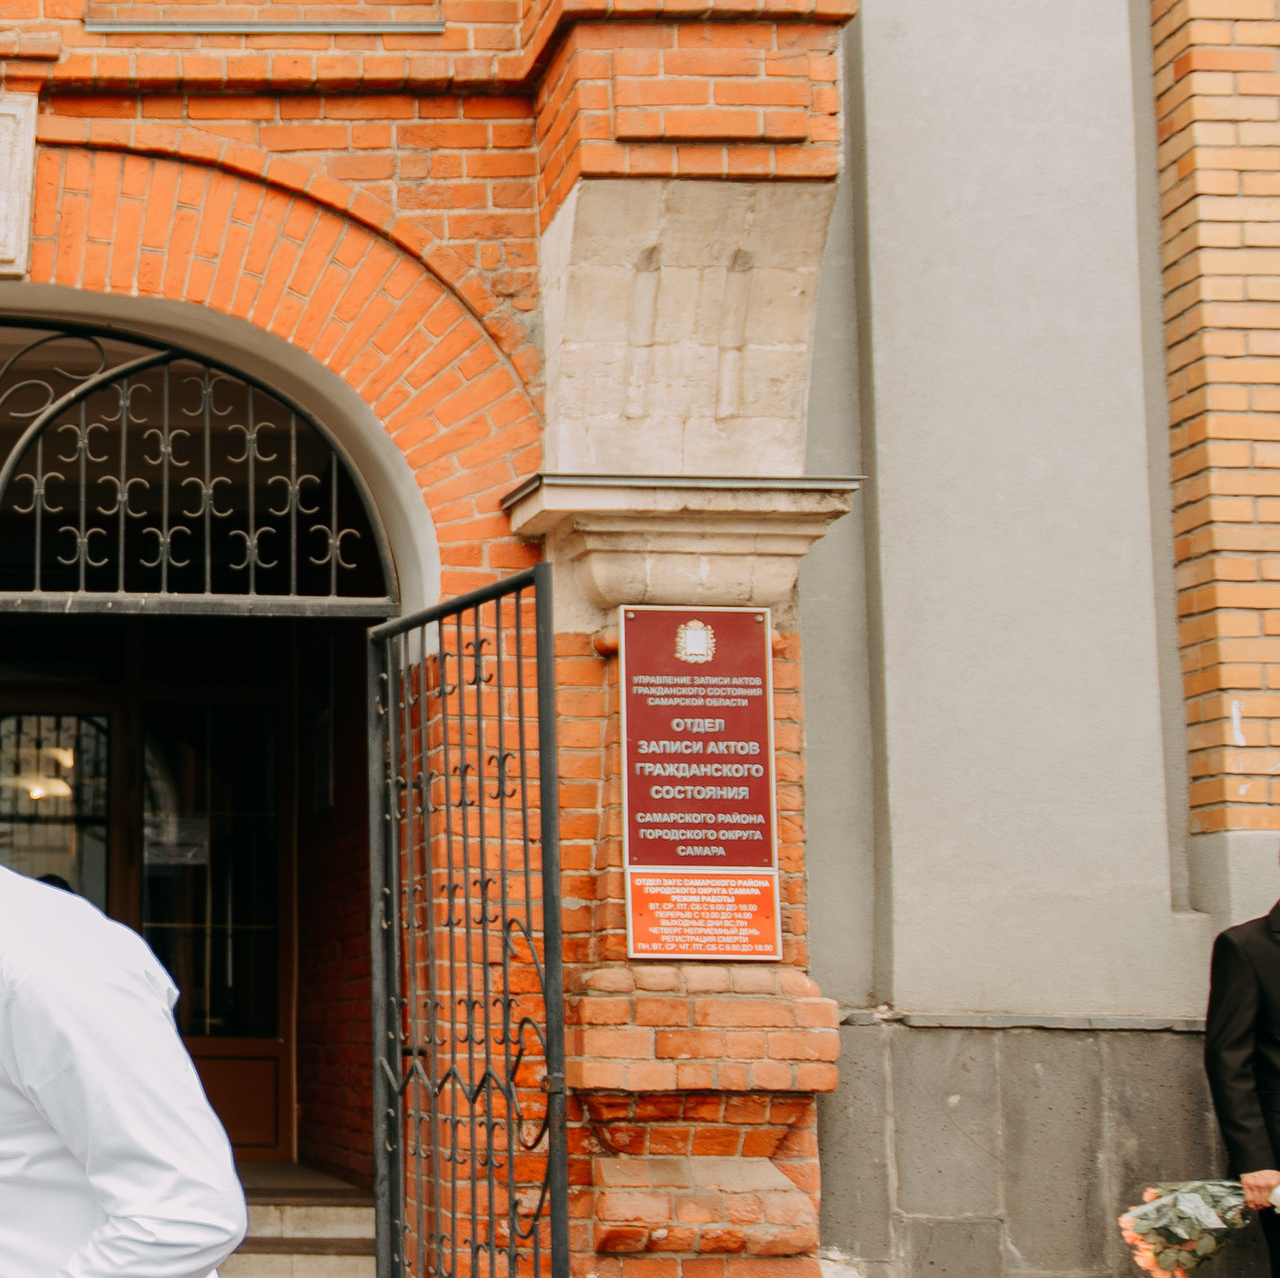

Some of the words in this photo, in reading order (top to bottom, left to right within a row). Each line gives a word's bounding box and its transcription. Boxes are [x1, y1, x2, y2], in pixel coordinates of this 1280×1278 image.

[633, 676, 692, 684] УПРАВЛЕНИЕ
[732, 677, 762, 685] АКТОВ
[633, 687, 705, 695] ГРАЖДАНСКОГО
[707, 688, 762, 696] СОСТОЯНИЯ
[647, 697, 704, 706] САМАРСКОЙ
[705, 698, 748, 706] ОБЛАСТИ
[672, 719, 725, 733] ОТДЕЛ
[638, 741, 703, 754] ЗАПИСИ
[707, 742, 760, 755] АКТОВ
[635, 763, 764, 778] ГРАЖДАНСКОГО
[650, 786, 749, 799] СОСТОЯНИЯ
[636, 813, 716, 823] САМАРСКОГО
[718, 812, 765, 823] РАЙОНА
[639, 829, 717, 840] ГОРОДСКОГО
[719, 830, 763, 840] ОКРУГА
[677, 846, 726, 856] САМАРА
[636, 878, 662, 886] ОТДЕЛ
